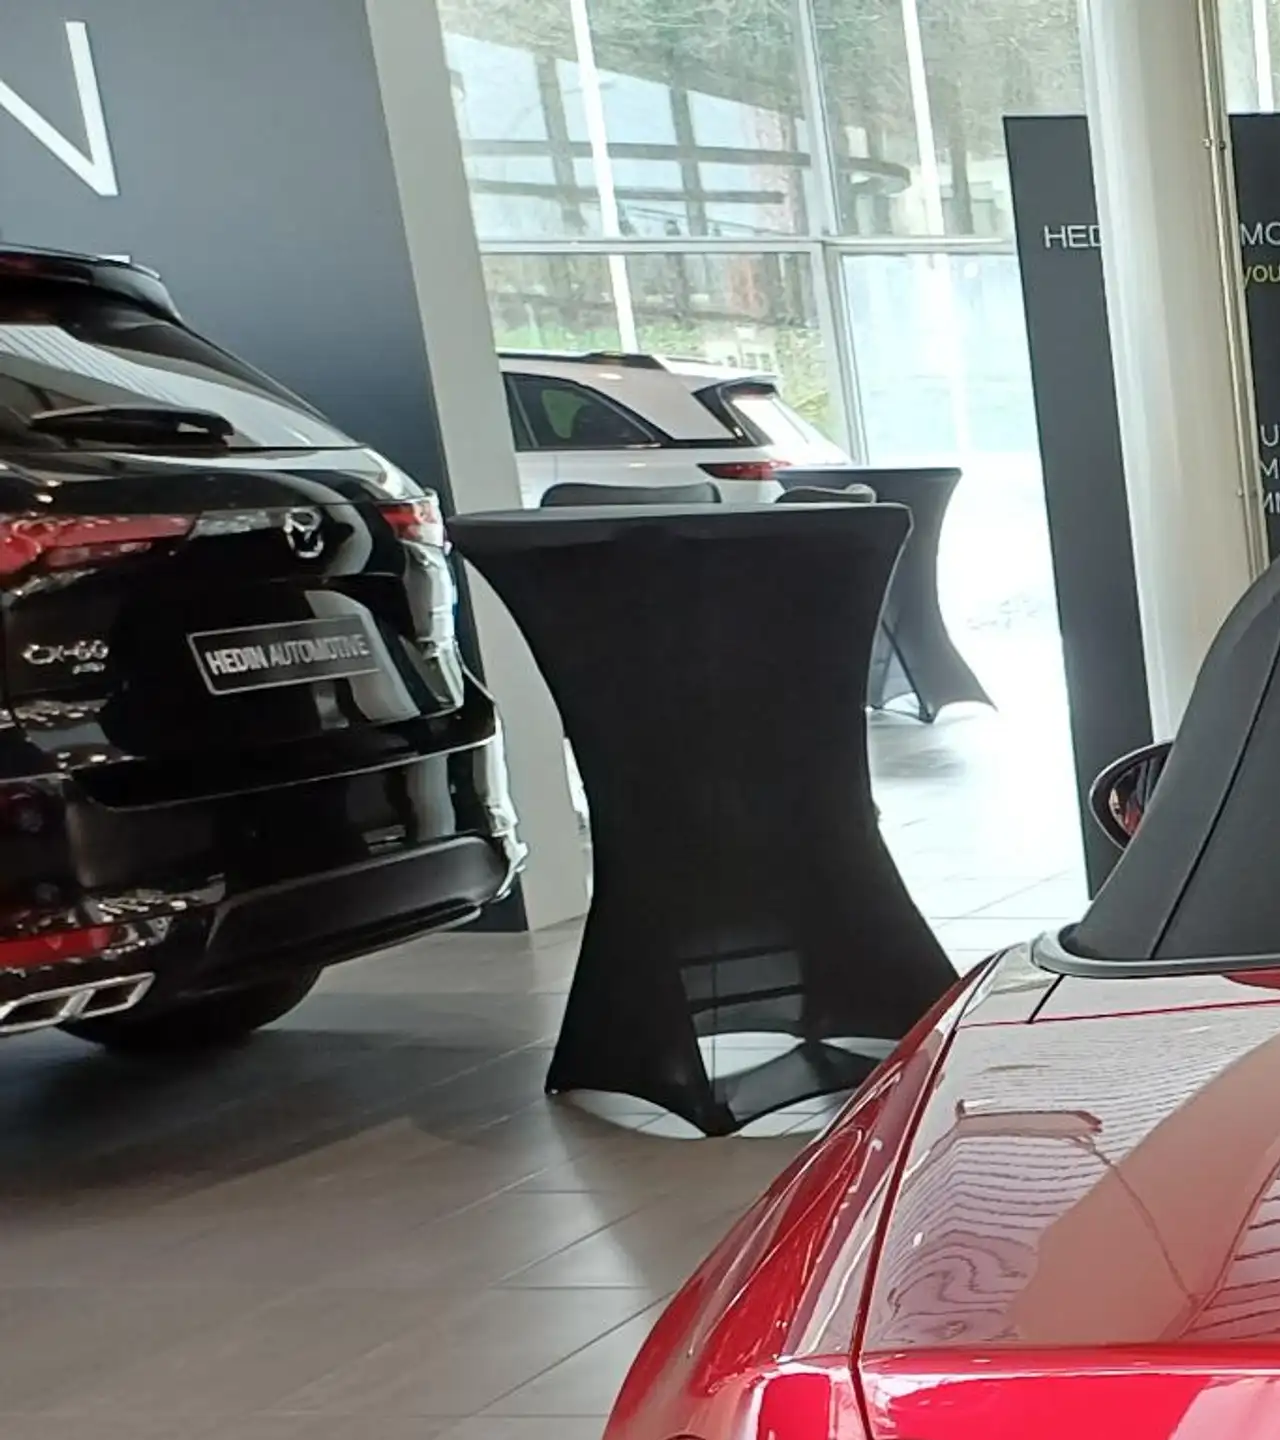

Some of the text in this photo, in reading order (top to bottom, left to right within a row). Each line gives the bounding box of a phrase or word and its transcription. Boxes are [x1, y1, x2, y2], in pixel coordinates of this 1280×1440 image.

[1043, 224, 1100, 248] HED
[205, 634, 370, 676] HEDIN AUTOMOTIVE
